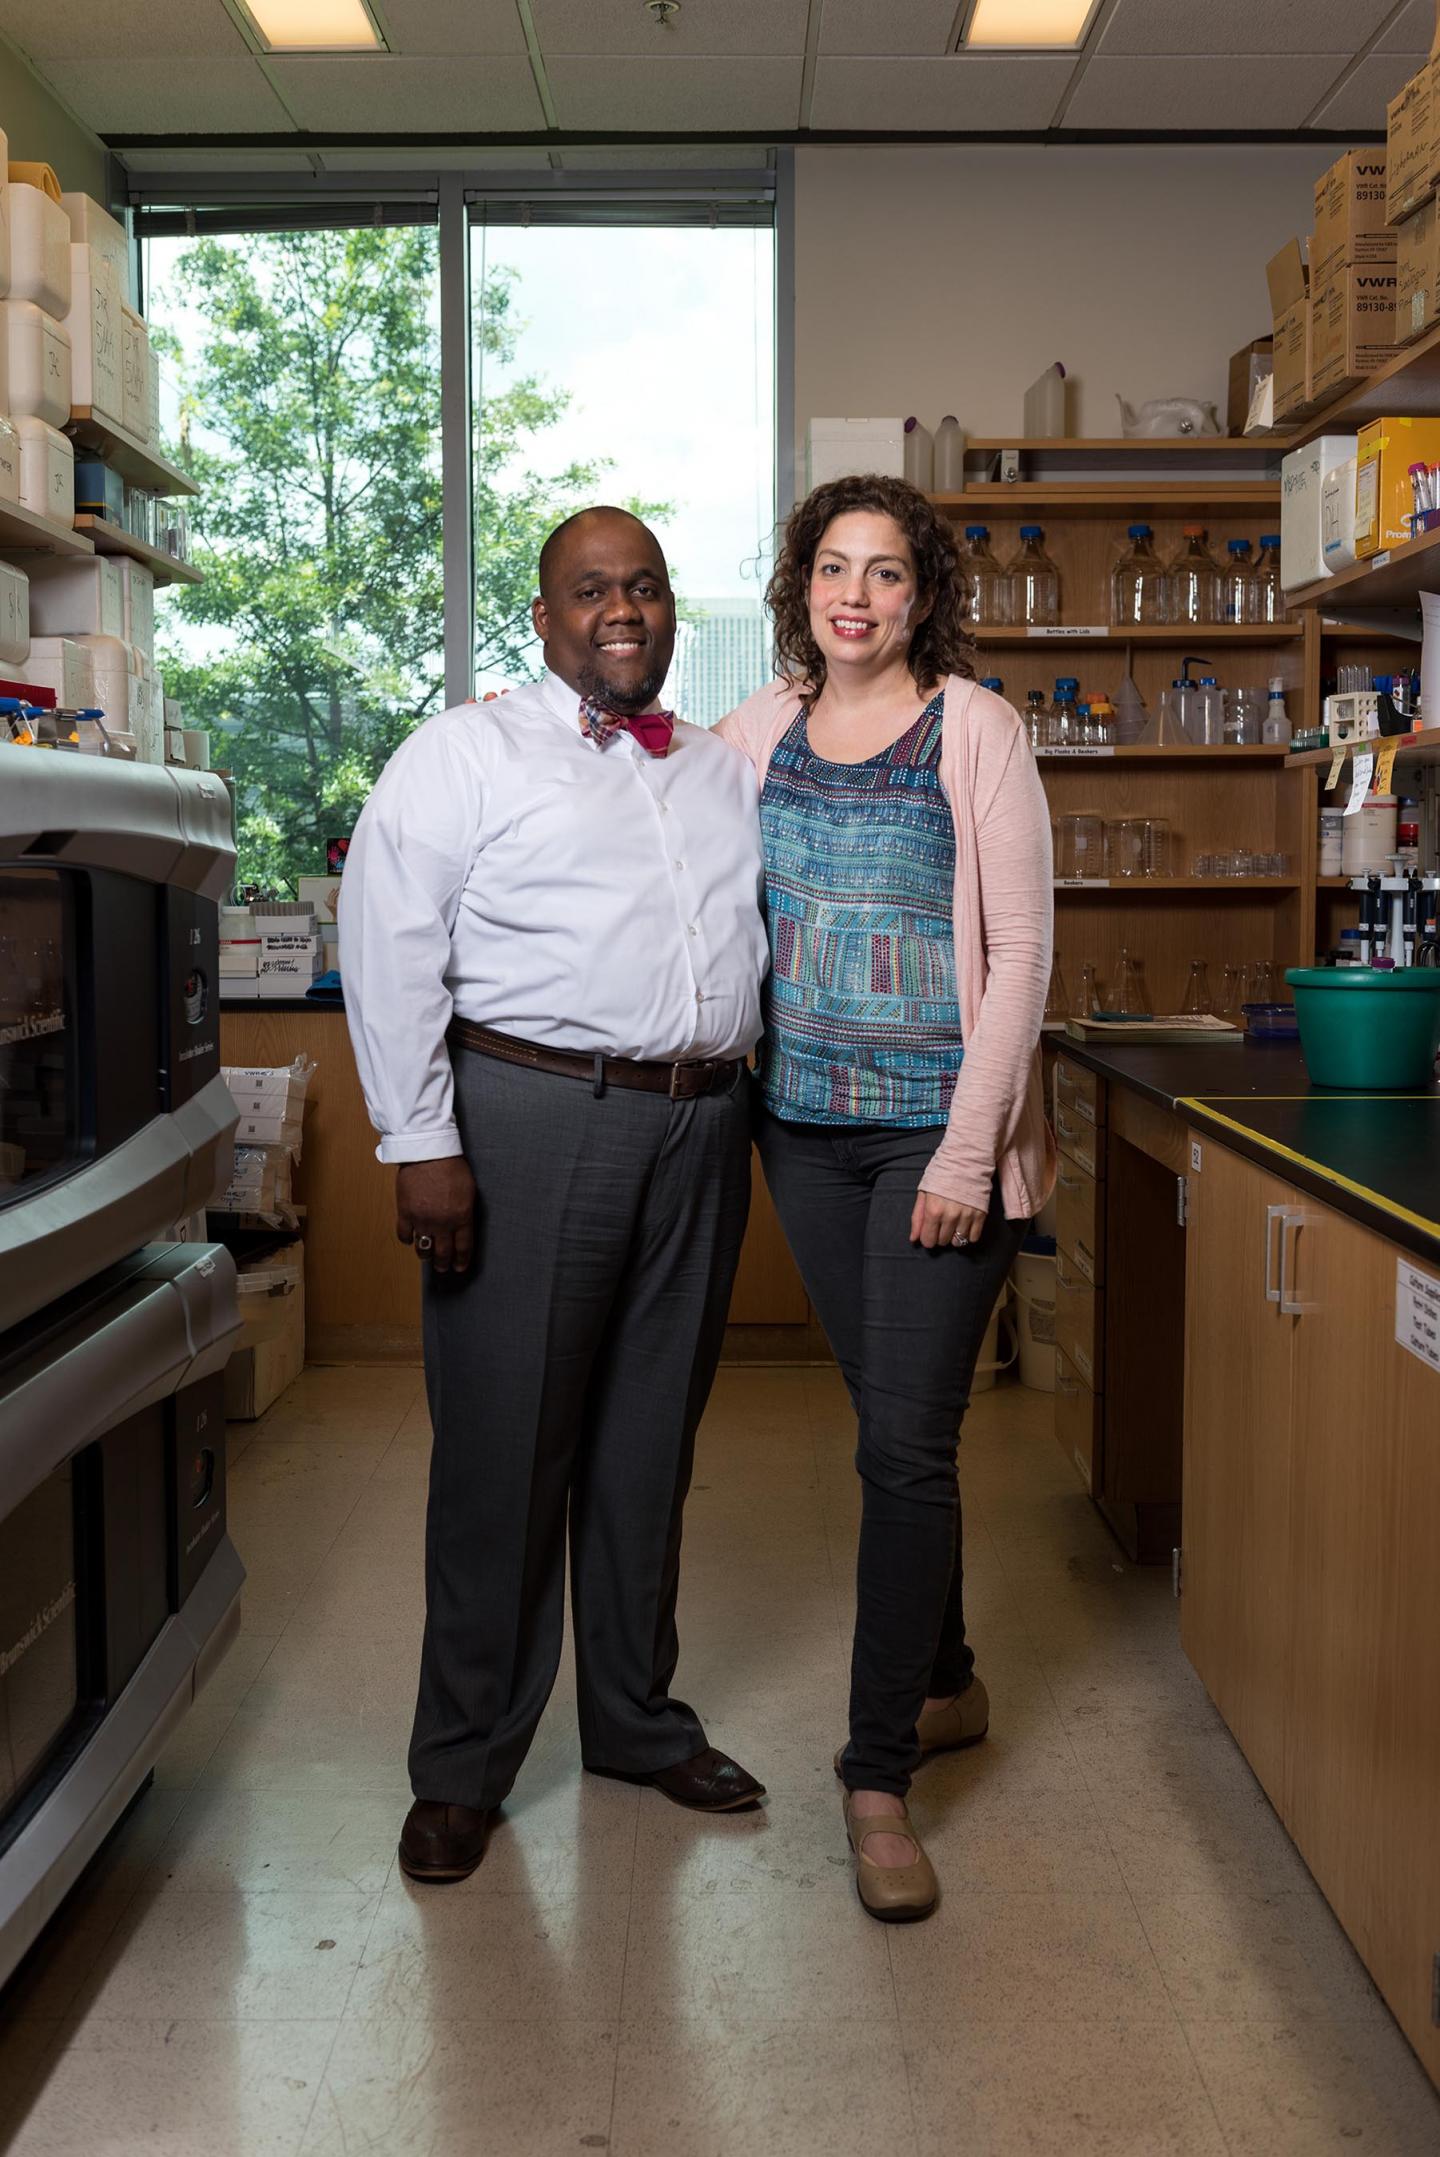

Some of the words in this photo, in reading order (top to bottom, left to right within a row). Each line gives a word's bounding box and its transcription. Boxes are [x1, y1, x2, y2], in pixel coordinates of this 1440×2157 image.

[1356, 165, 1386, 176] VW
[1356, 190, 1386, 201] 89130
[1356, 277, 1397, 288] VWR
[30, 1008, 65, 1037] Scientific
[42, 1580, 77, 1631] Scientific
